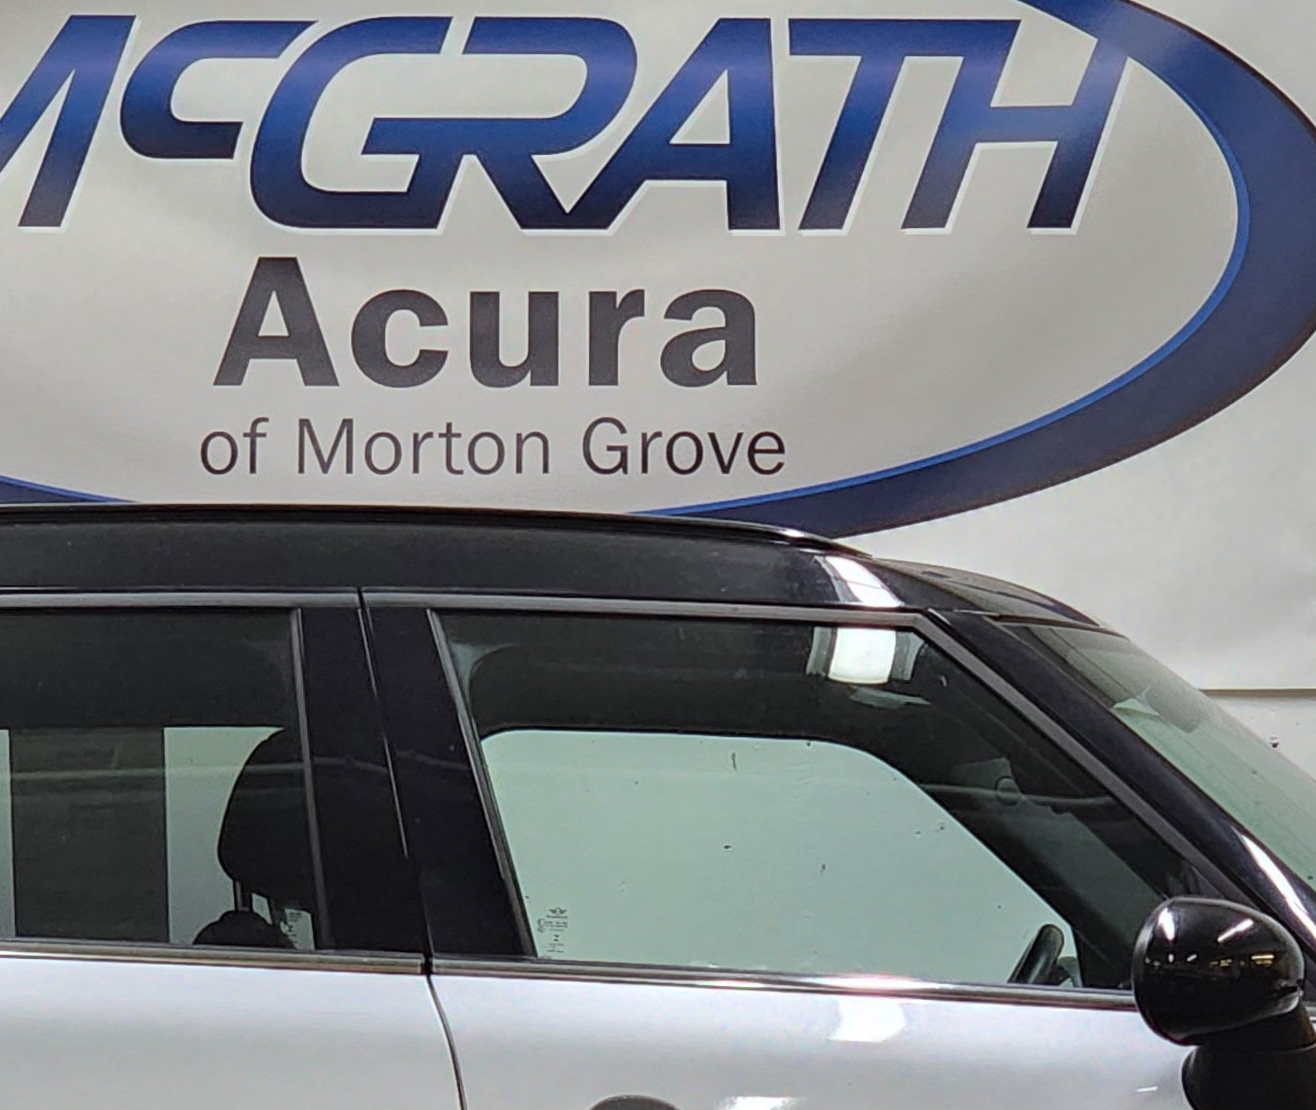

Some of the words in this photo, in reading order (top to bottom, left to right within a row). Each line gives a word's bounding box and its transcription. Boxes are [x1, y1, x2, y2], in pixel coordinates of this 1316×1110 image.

[211, 255, 759, 390] Acura
[199, 415, 271, 476] of
[296, 417, 551, 476] Morton
[581, 415, 787, 477] Grove
